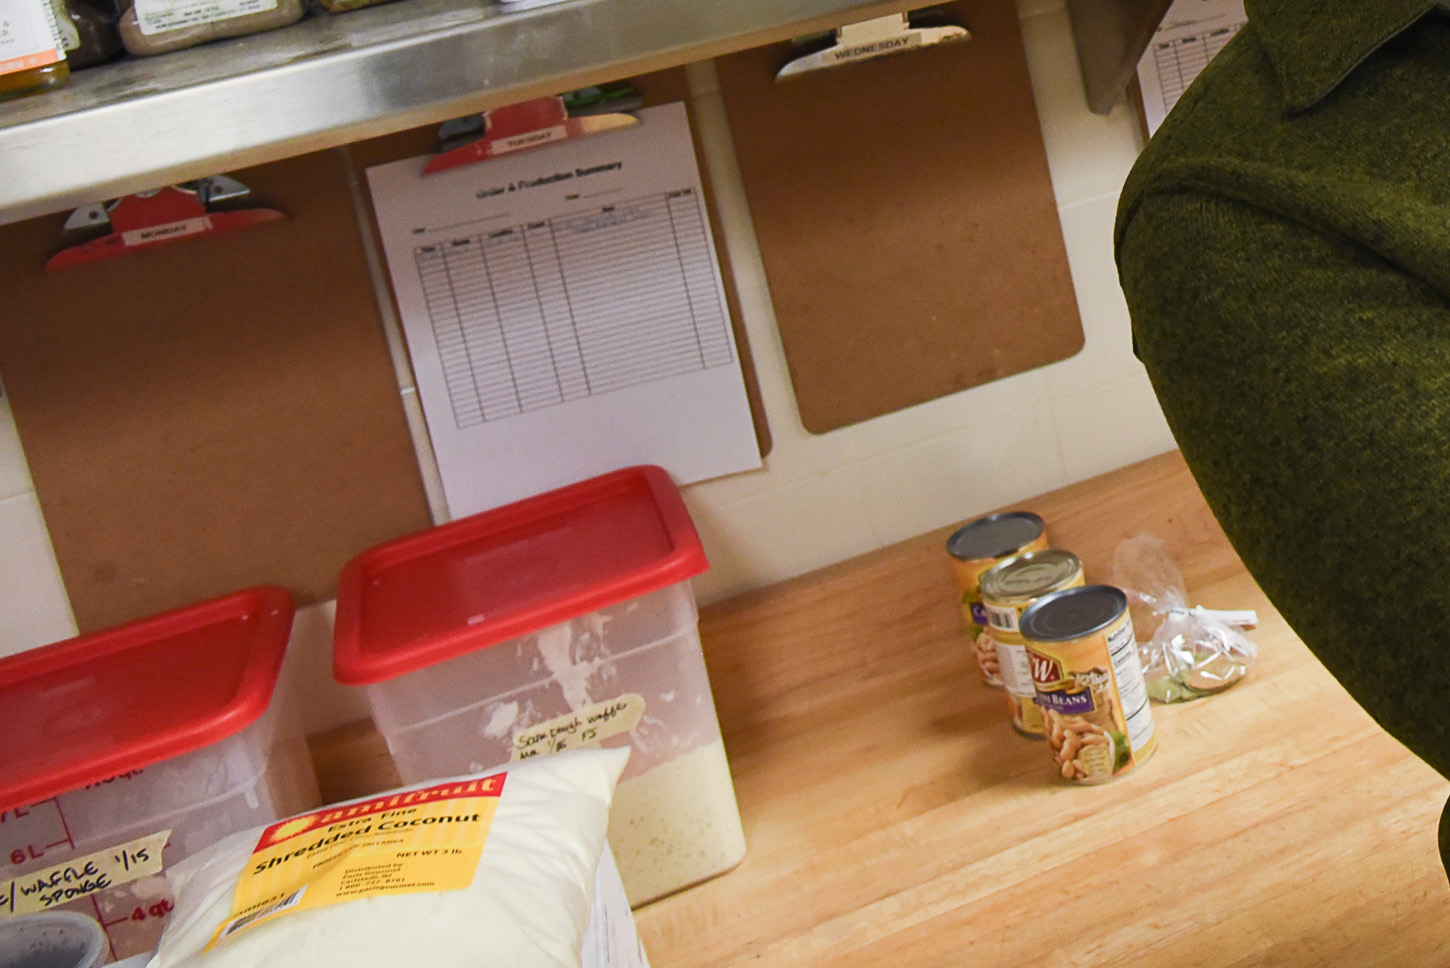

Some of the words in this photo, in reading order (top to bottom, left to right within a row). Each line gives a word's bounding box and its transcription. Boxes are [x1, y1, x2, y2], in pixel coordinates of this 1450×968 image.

[834, 37, 910, 60] WEDNESDAY
[508, 132, 552, 147] TUESDAY
[517, 172, 574, 190] Production
[576, 161, 623, 177] Summary
[141, 223, 188, 240] MONDAY
[1053, 694, 1087, 706] BEANS
[327, 816, 372, 833] Extra
[381, 807, 417, 820] Fine
[10, 844, 45, 864] 6L
[252, 823, 372, 875] Shredded
[378, 812, 482, 831] Coconut
[396, 850, 419, 858] NET
[20, 861, 98, 896] WAFFLE
[114, 848, 150, 871] 1/15
[345, 863, 392, 874] Distributed
[39, 873, 112, 907] SPONGE
